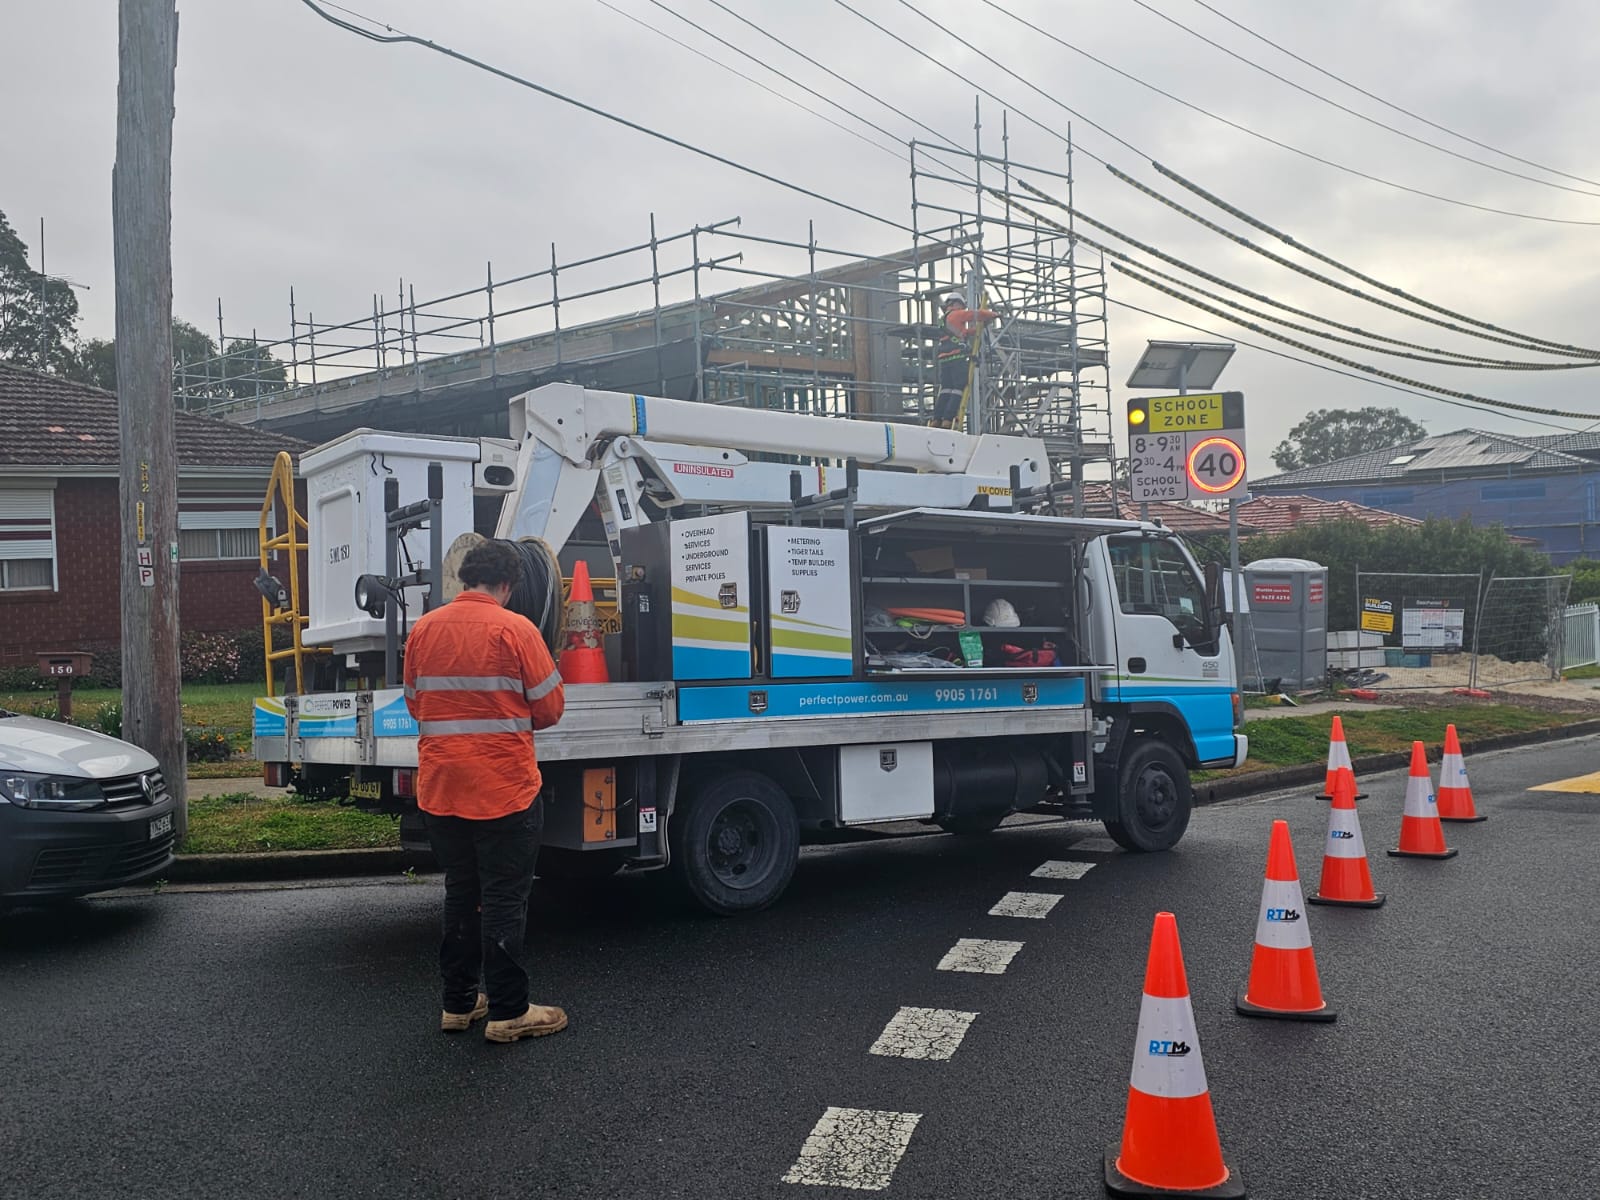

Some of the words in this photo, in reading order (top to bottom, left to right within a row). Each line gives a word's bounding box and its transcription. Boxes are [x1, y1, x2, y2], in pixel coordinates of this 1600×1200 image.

[1153, 399, 1218, 412] SCHOOL
[1164, 414, 1208, 426] ZONE
[677, 464, 732, 477] UNINSULATED
[1197, 453, 1237, 477] 40
[1136, 476, 1181, 487] SCHOOL
[1143, 487, 1176, 497] DAYS
[685, 528, 715, 538] OVERHEAD
[684, 539, 711, 549] SERVICES
[791, 537, 821, 546] METERING
[140, 552, 150, 564] H
[686, 549, 729, 560] UNDERGROUND
[685, 562, 712, 571] SERVICES
[791, 558, 807, 566] TEMP
[808, 559, 835, 567] BUILDERS
[142, 570, 151, 582] P
[685, 573, 707, 583] PRIVATE
[708, 572, 726, 580] POLES
[50, 666, 73, 674] 150
[799, 692, 909, 707] perfectpower.com.au
[935, 688, 966, 702] 9905
[970, 687, 998, 701] 1761
[1266, 908, 1297, 921] RTM
[1149, 1039, 1186, 1055] RTM
